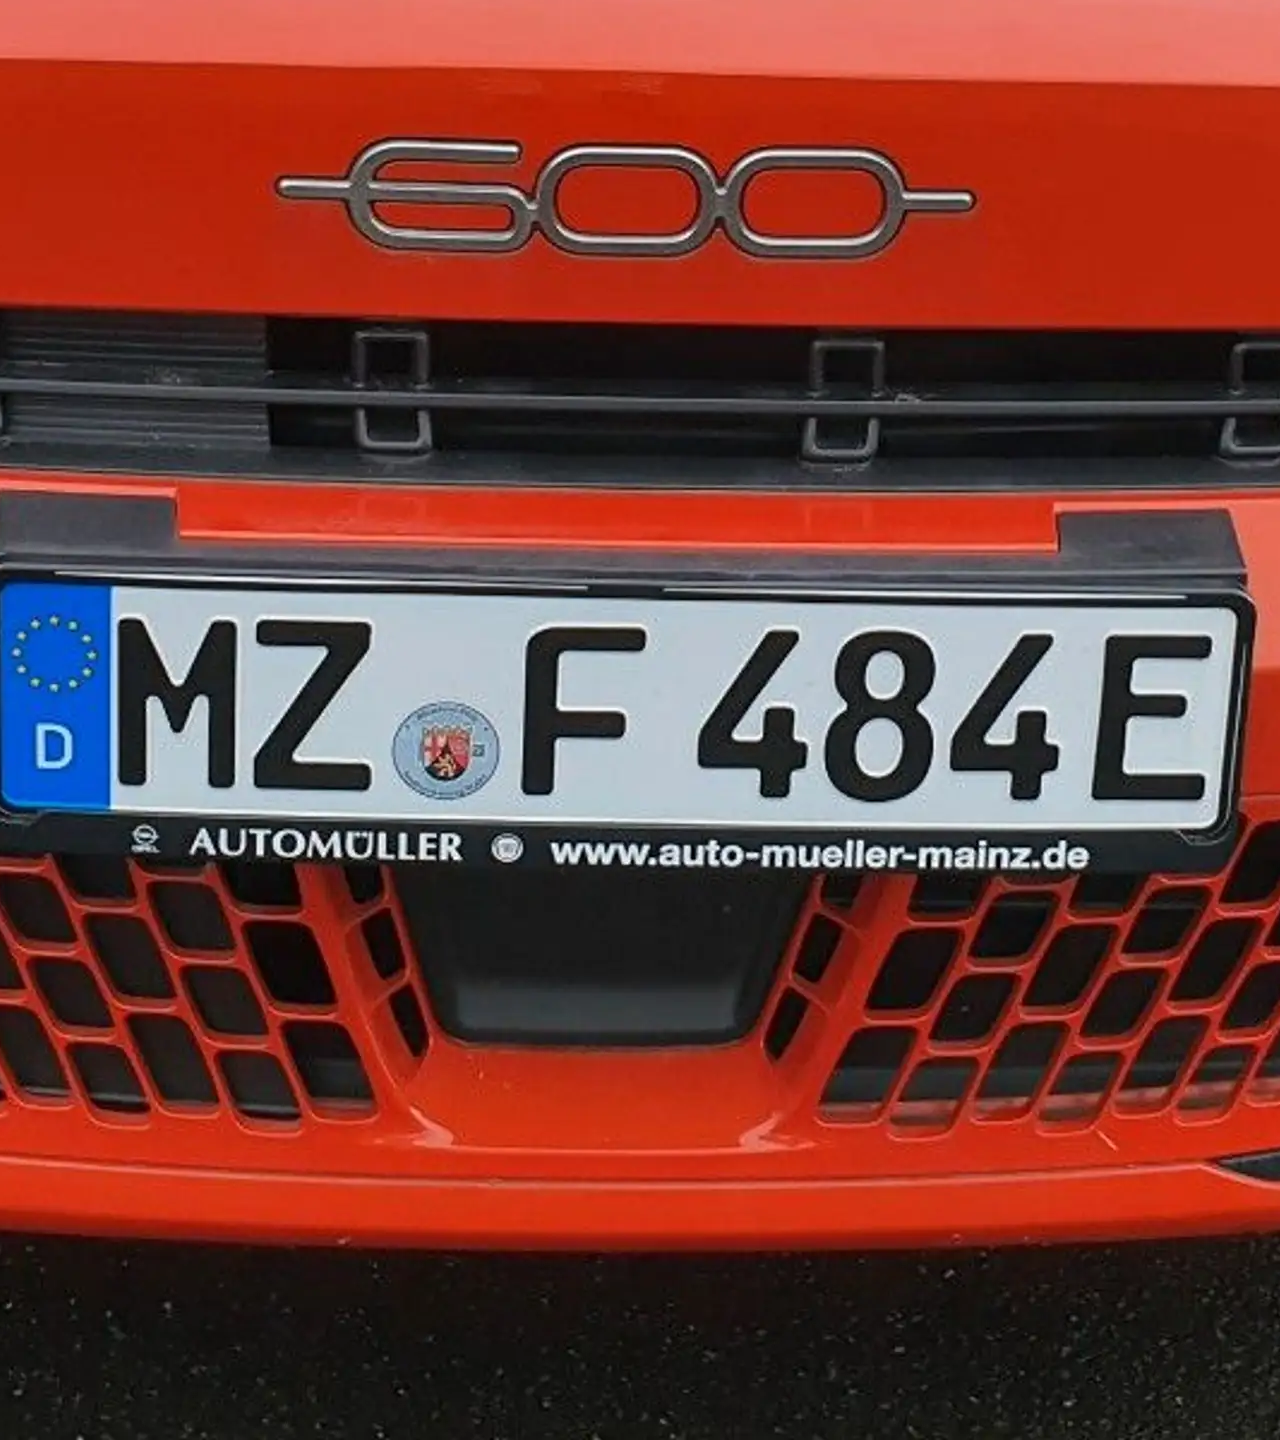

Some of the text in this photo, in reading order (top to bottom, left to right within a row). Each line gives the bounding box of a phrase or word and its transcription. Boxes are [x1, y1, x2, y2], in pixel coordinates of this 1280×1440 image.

[340, 135, 915, 261] 600
[35, 724, 73, 769] D
[118, 618, 1212, 803] MZ F 484E
[188, 827, 464, 861] AUTOMÜLLER
[549, 838, 1091, 871] www.auto-mueller-mainz.de
